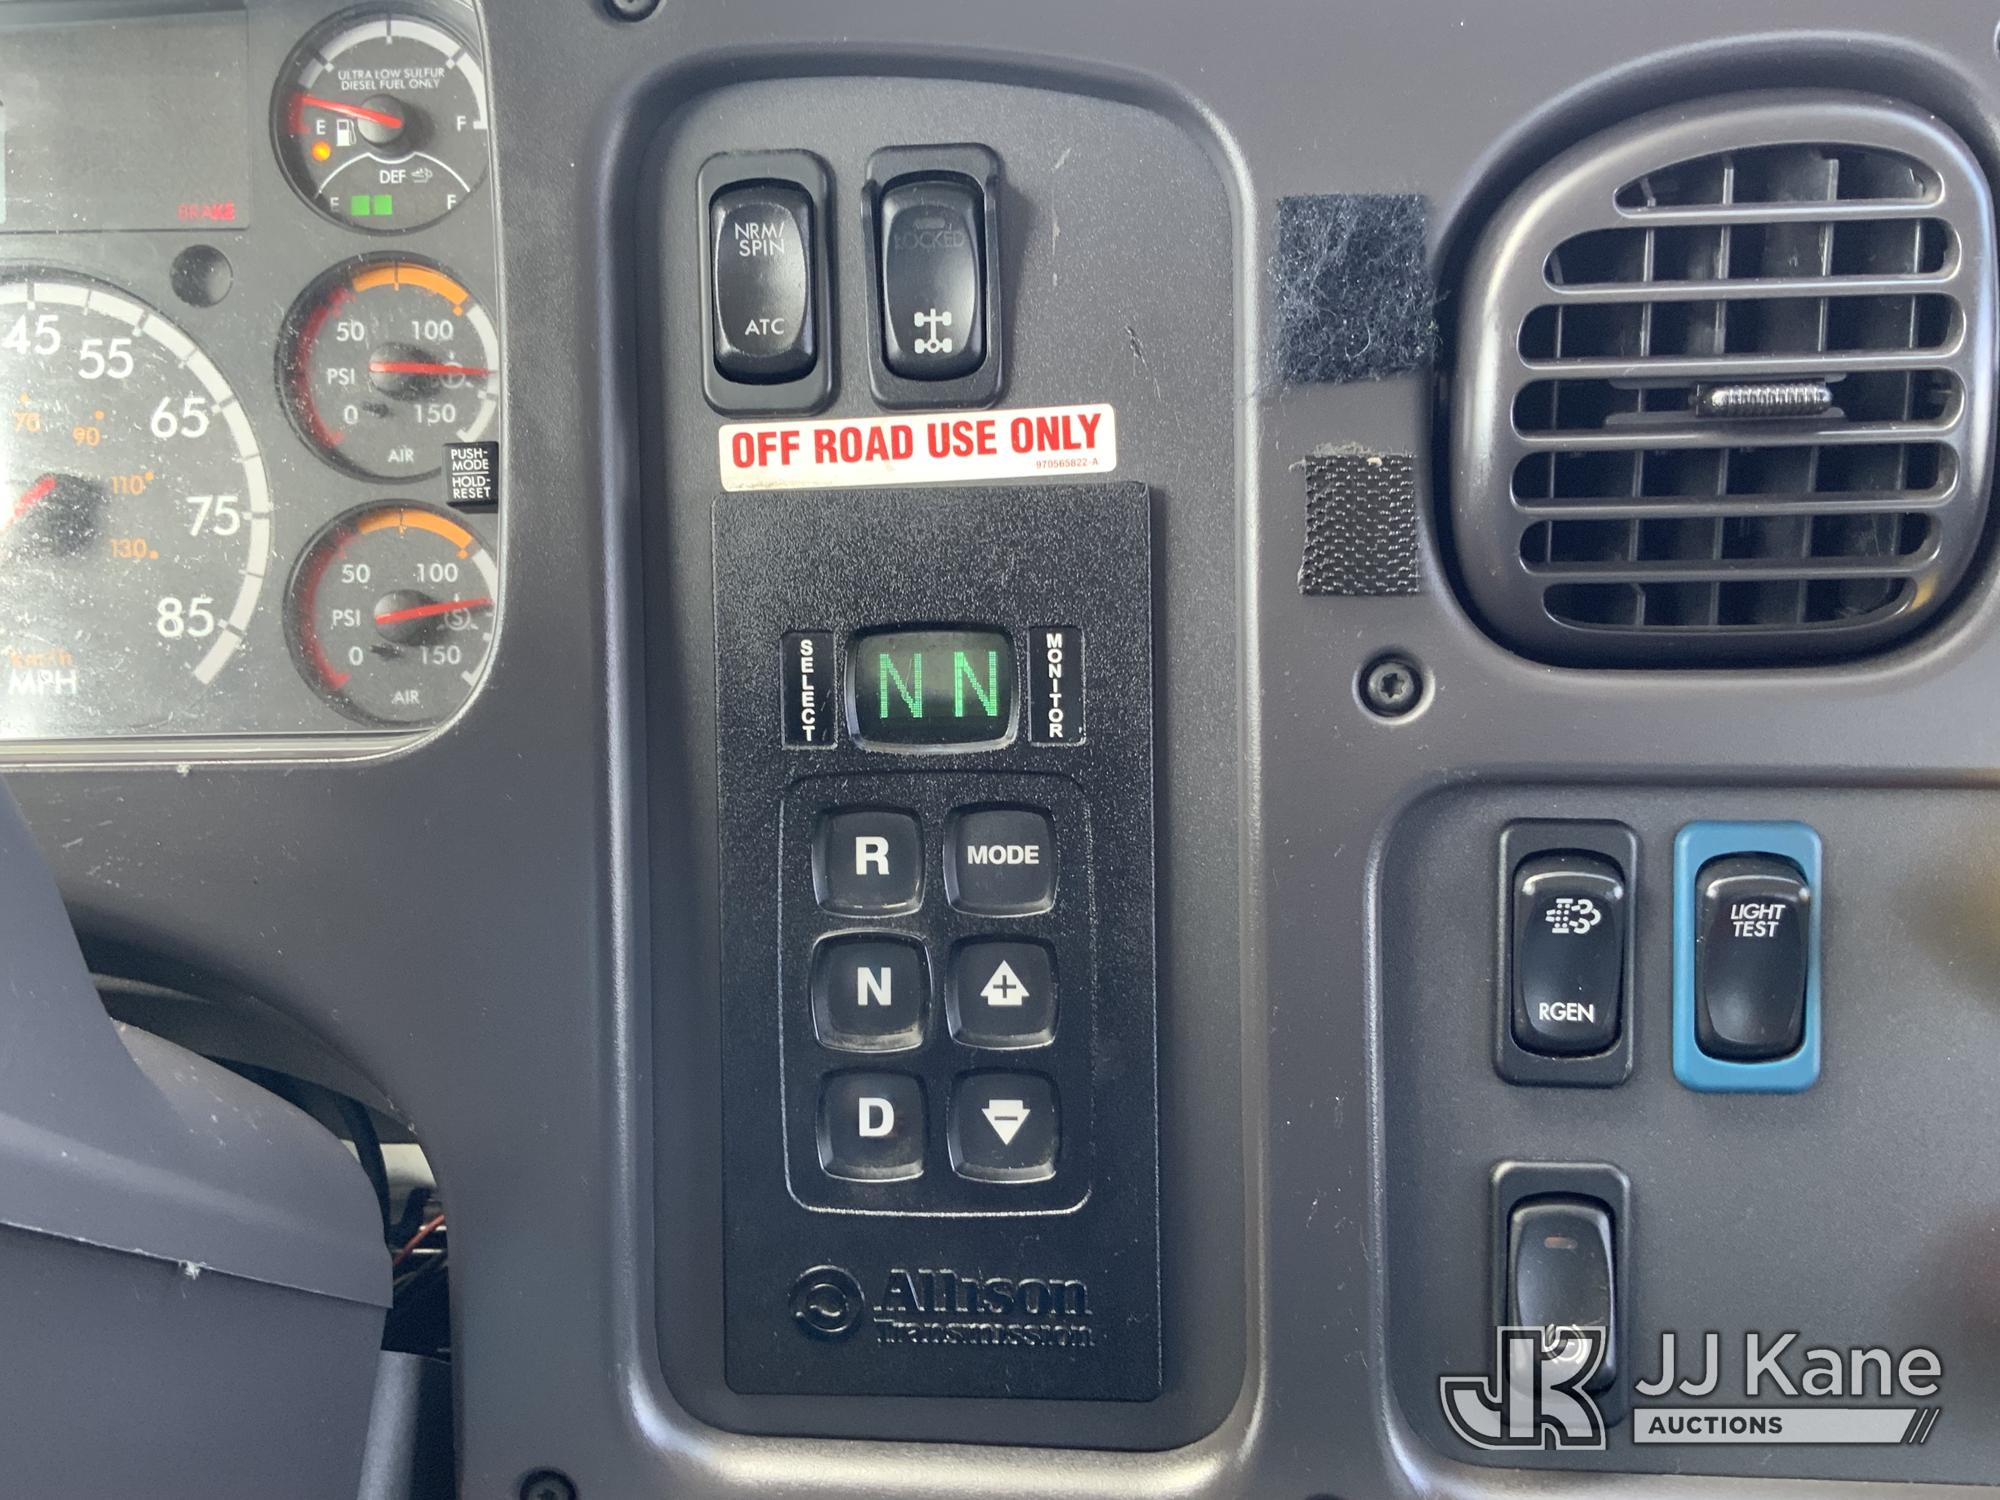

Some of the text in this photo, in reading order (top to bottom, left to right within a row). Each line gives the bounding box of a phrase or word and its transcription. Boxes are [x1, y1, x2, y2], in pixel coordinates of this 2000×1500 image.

[338, 67, 445, 81] ULTRA LOW SULFUR
[341, 78, 440, 90] DIESEL FUEL ONLY
[316, 119, 326, 135] E
[456, 115, 466, 132] F
[379, 169, 406, 184] DEF
[330, 196, 339, 212] E
[447, 194, 457, 210] F
[734, 221, 784, 240] NRM/
[738, 238, 785, 257] SPIN
[1, 314, 61, 355] 45
[336, 321, 365, 342] 50
[411, 320, 454, 341] 100
[744, 318, 785, 336] ATC
[78, 337, 134, 380] 55
[326, 368, 355, 386] PSI
[151, 396, 210, 439] 65
[414, 403, 456, 424] 150
[732, 413, 1102, 469] OFF ROAD USE ONLY
[388, 448, 414, 463] AIR
[451, 447, 488, 460] PUSH-
[452, 458, 489, 471] MODE
[111, 475, 145, 496] 110
[452, 475, 491, 488] HOLD-
[453, 486, 491, 499] RESET
[186, 495, 241, 537] 75
[110, 538, 147, 559] 130
[342, 563, 371, 584] 50
[416, 562, 458, 583] 100
[156, 597, 215, 638] 85
[333, 609, 361, 627] PSI
[421, 645, 461, 665] 150
[8, 669, 77, 695] MPH
[800, 638, 815, 742] SELECT
[879, 651, 997, 719] N N
[1046, 633, 1064, 738] MONITOR
[392, 690, 420, 704] AIR
[855, 836, 890, 875] R
[967, 845, 1040, 865] MODE
[1730, 903, 1786, 921] LIGHT
[1733, 920, 1779, 938] TEST
[857, 966, 892, 1006] N
[1538, 1001, 1595, 1024] RGEN
[858, 1097, 895, 1137] D
[873, 1267, 1094, 1315] Allison
